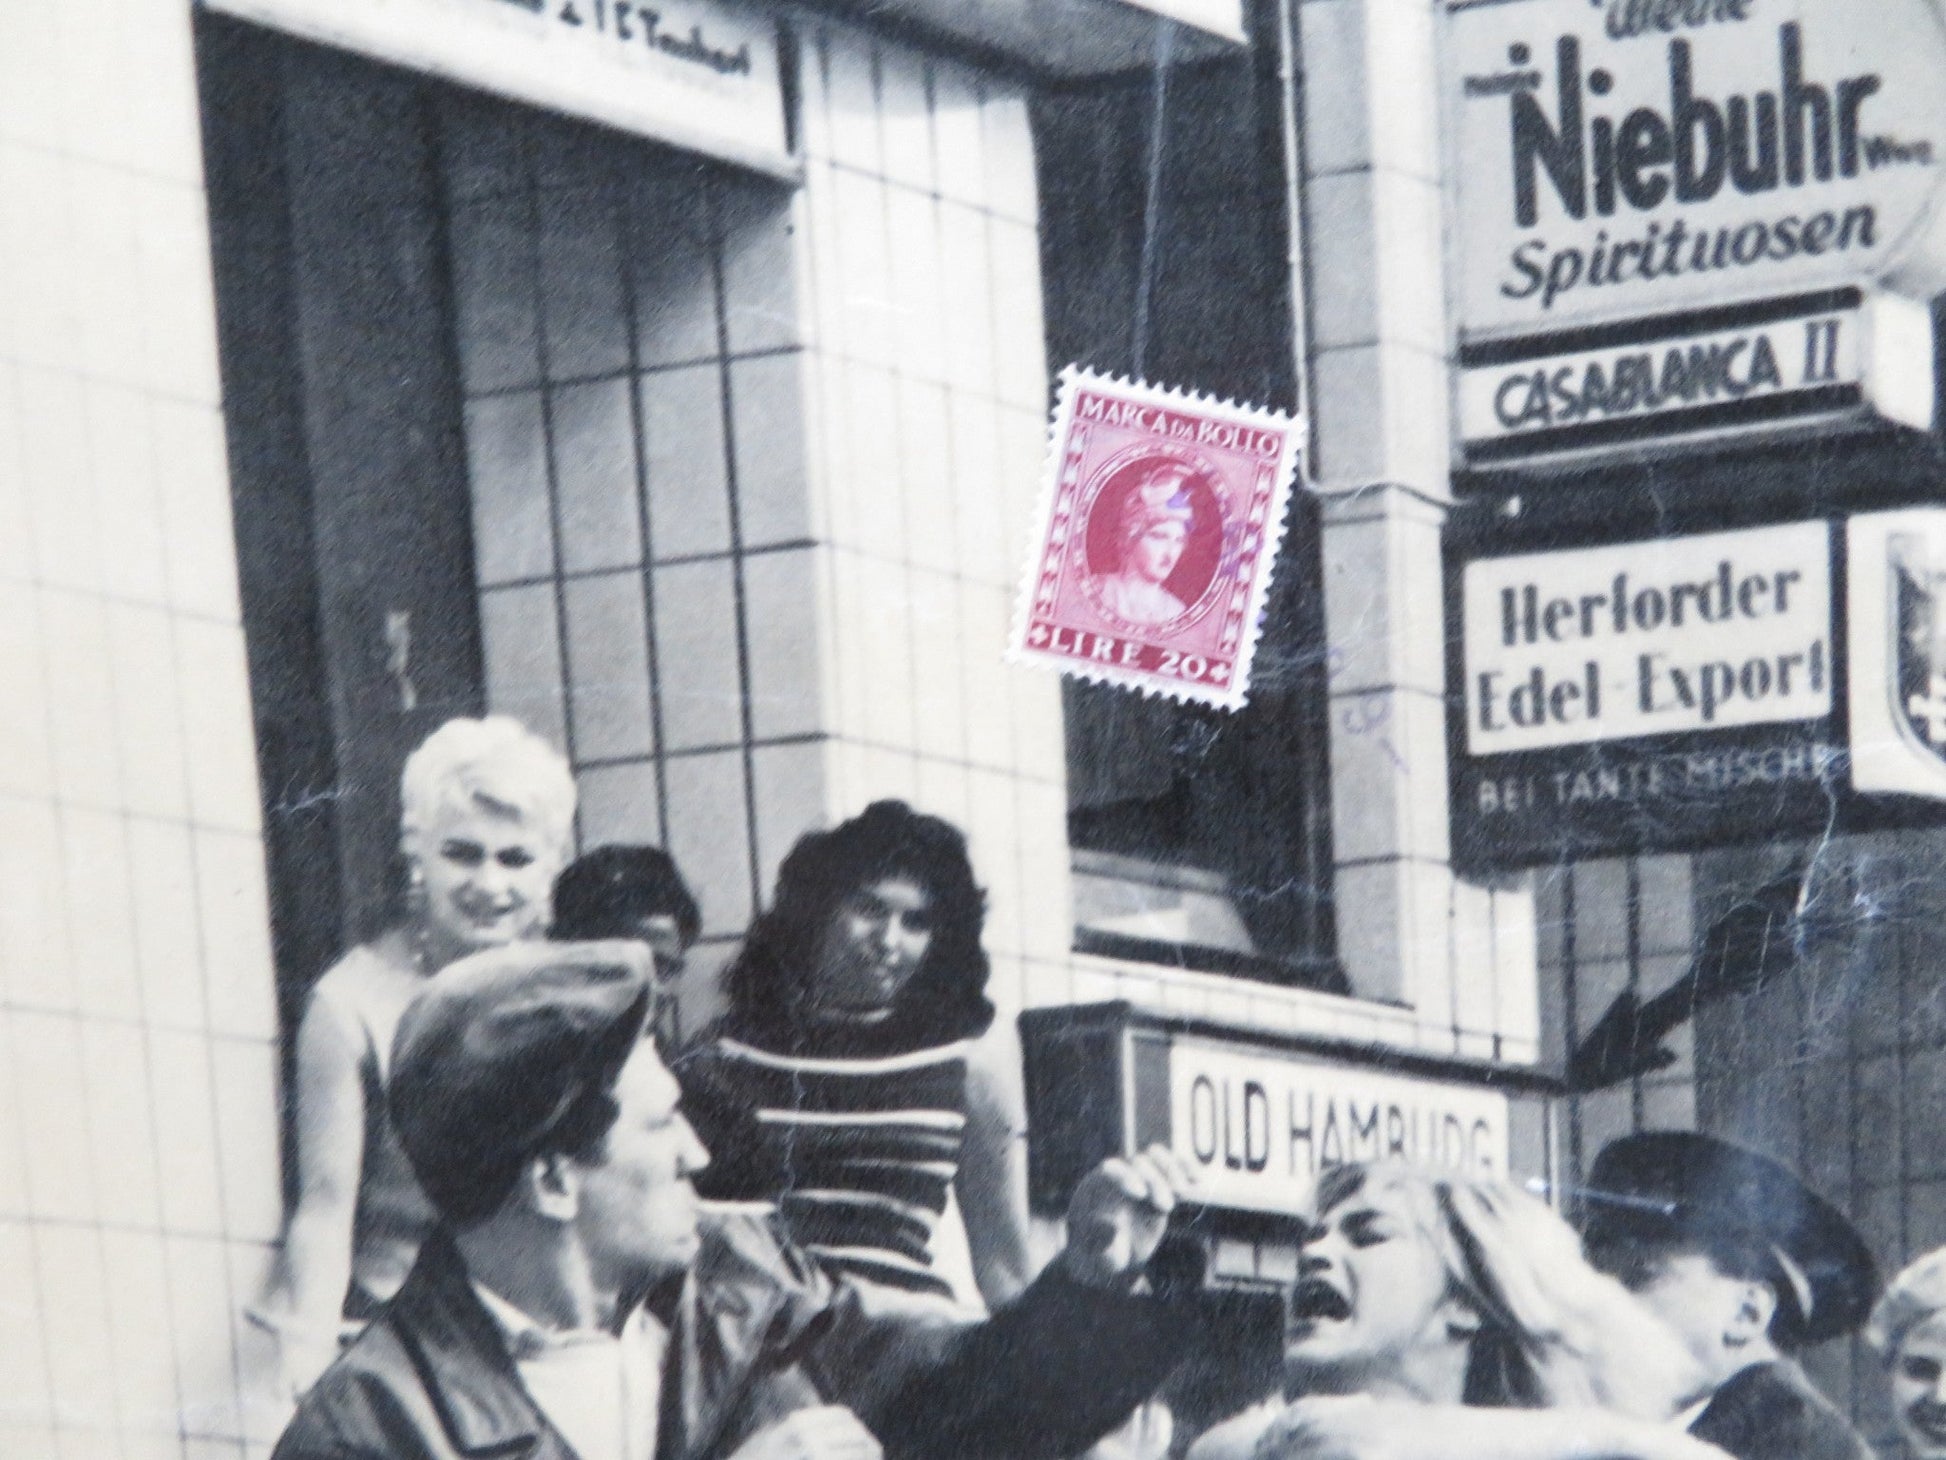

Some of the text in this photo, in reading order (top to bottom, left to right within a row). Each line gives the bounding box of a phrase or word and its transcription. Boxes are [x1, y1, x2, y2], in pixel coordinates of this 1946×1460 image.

[1510, 20, 1882, 228] Niebuhr
[1501, 204, 1877, 309] Spirituosen
[1079, 395, 1168, 436] MARCA
[1196, 419, 1281, 458] BOLLO
[1493, 334, 1782, 429] CASABLANCA
[1500, 559, 1802, 646] Herforder
[1051, 627, 1208, 681] LIRE 20
[1479, 775, 1537, 815] BEI
[1554, 762, 1665, 804] TANTE
[1190, 1074, 1271, 1173] OLD
